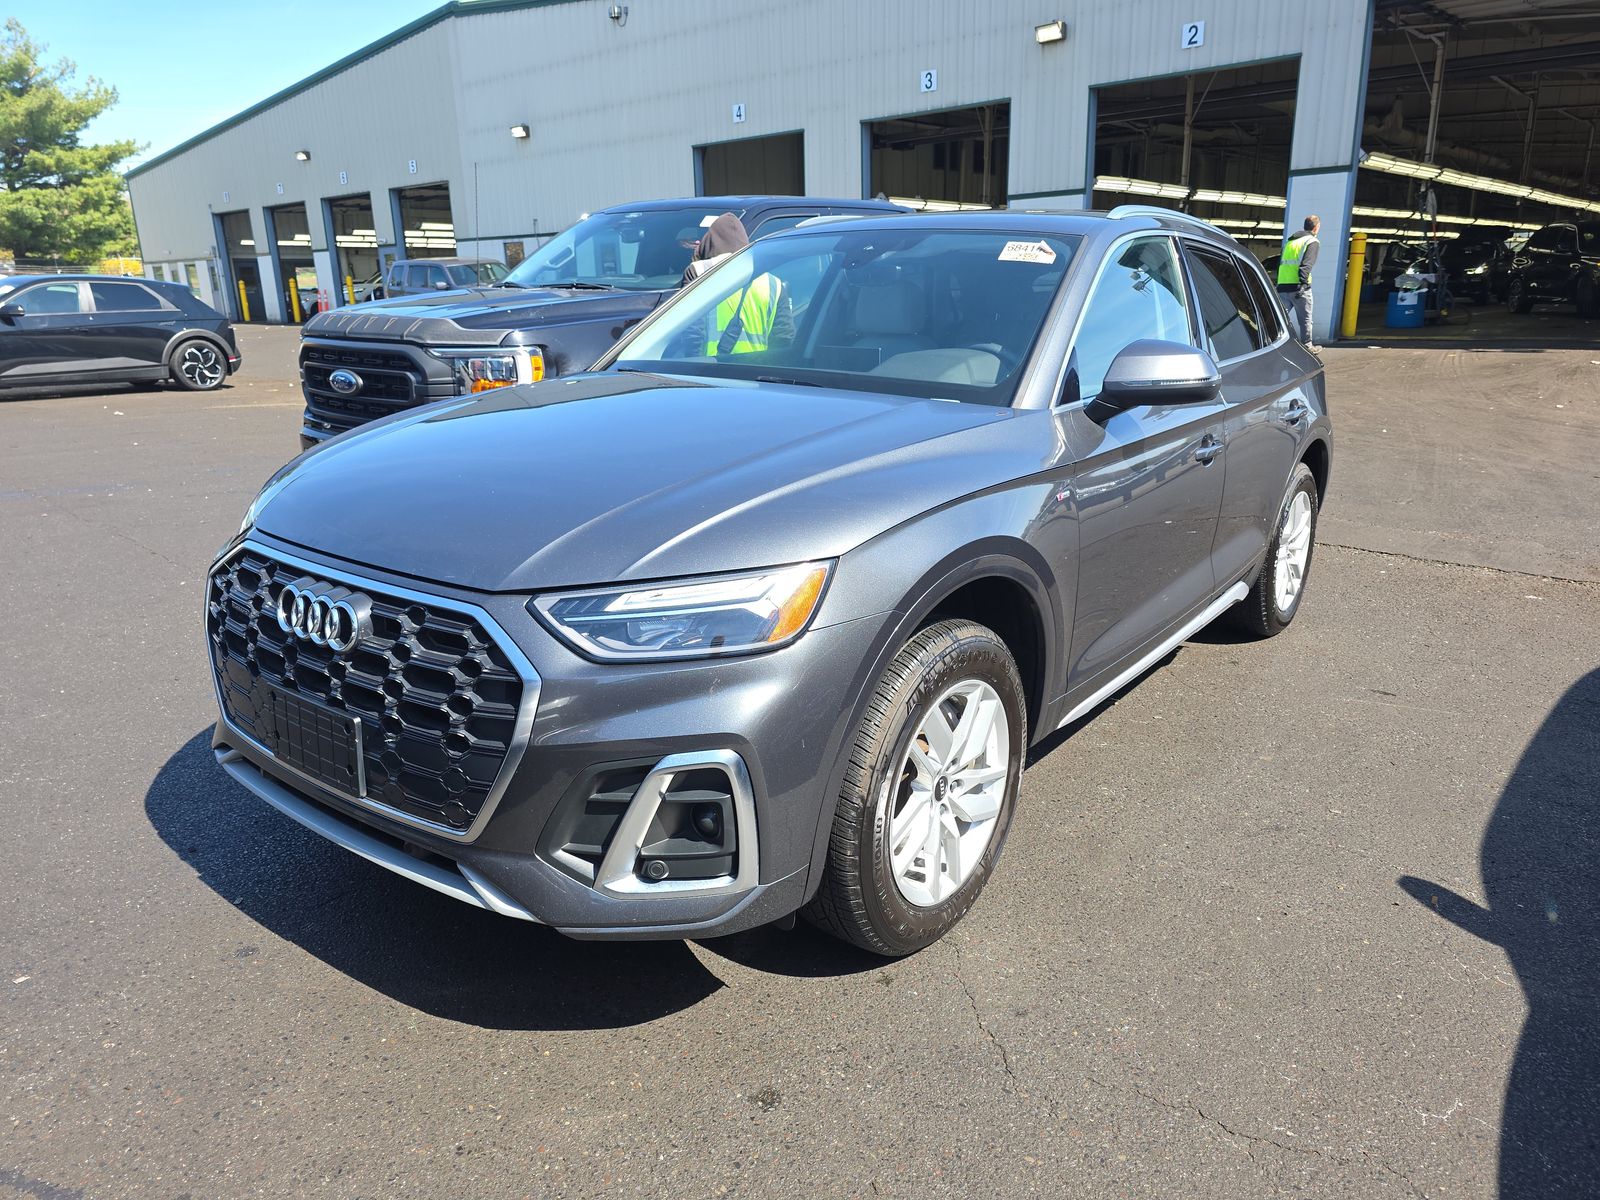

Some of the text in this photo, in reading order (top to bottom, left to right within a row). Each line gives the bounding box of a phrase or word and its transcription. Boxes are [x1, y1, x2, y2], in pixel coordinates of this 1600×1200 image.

[1187, 24, 1199, 46] 2
[925, 72, 933, 89] 3
[736, 105, 742, 121] 4
